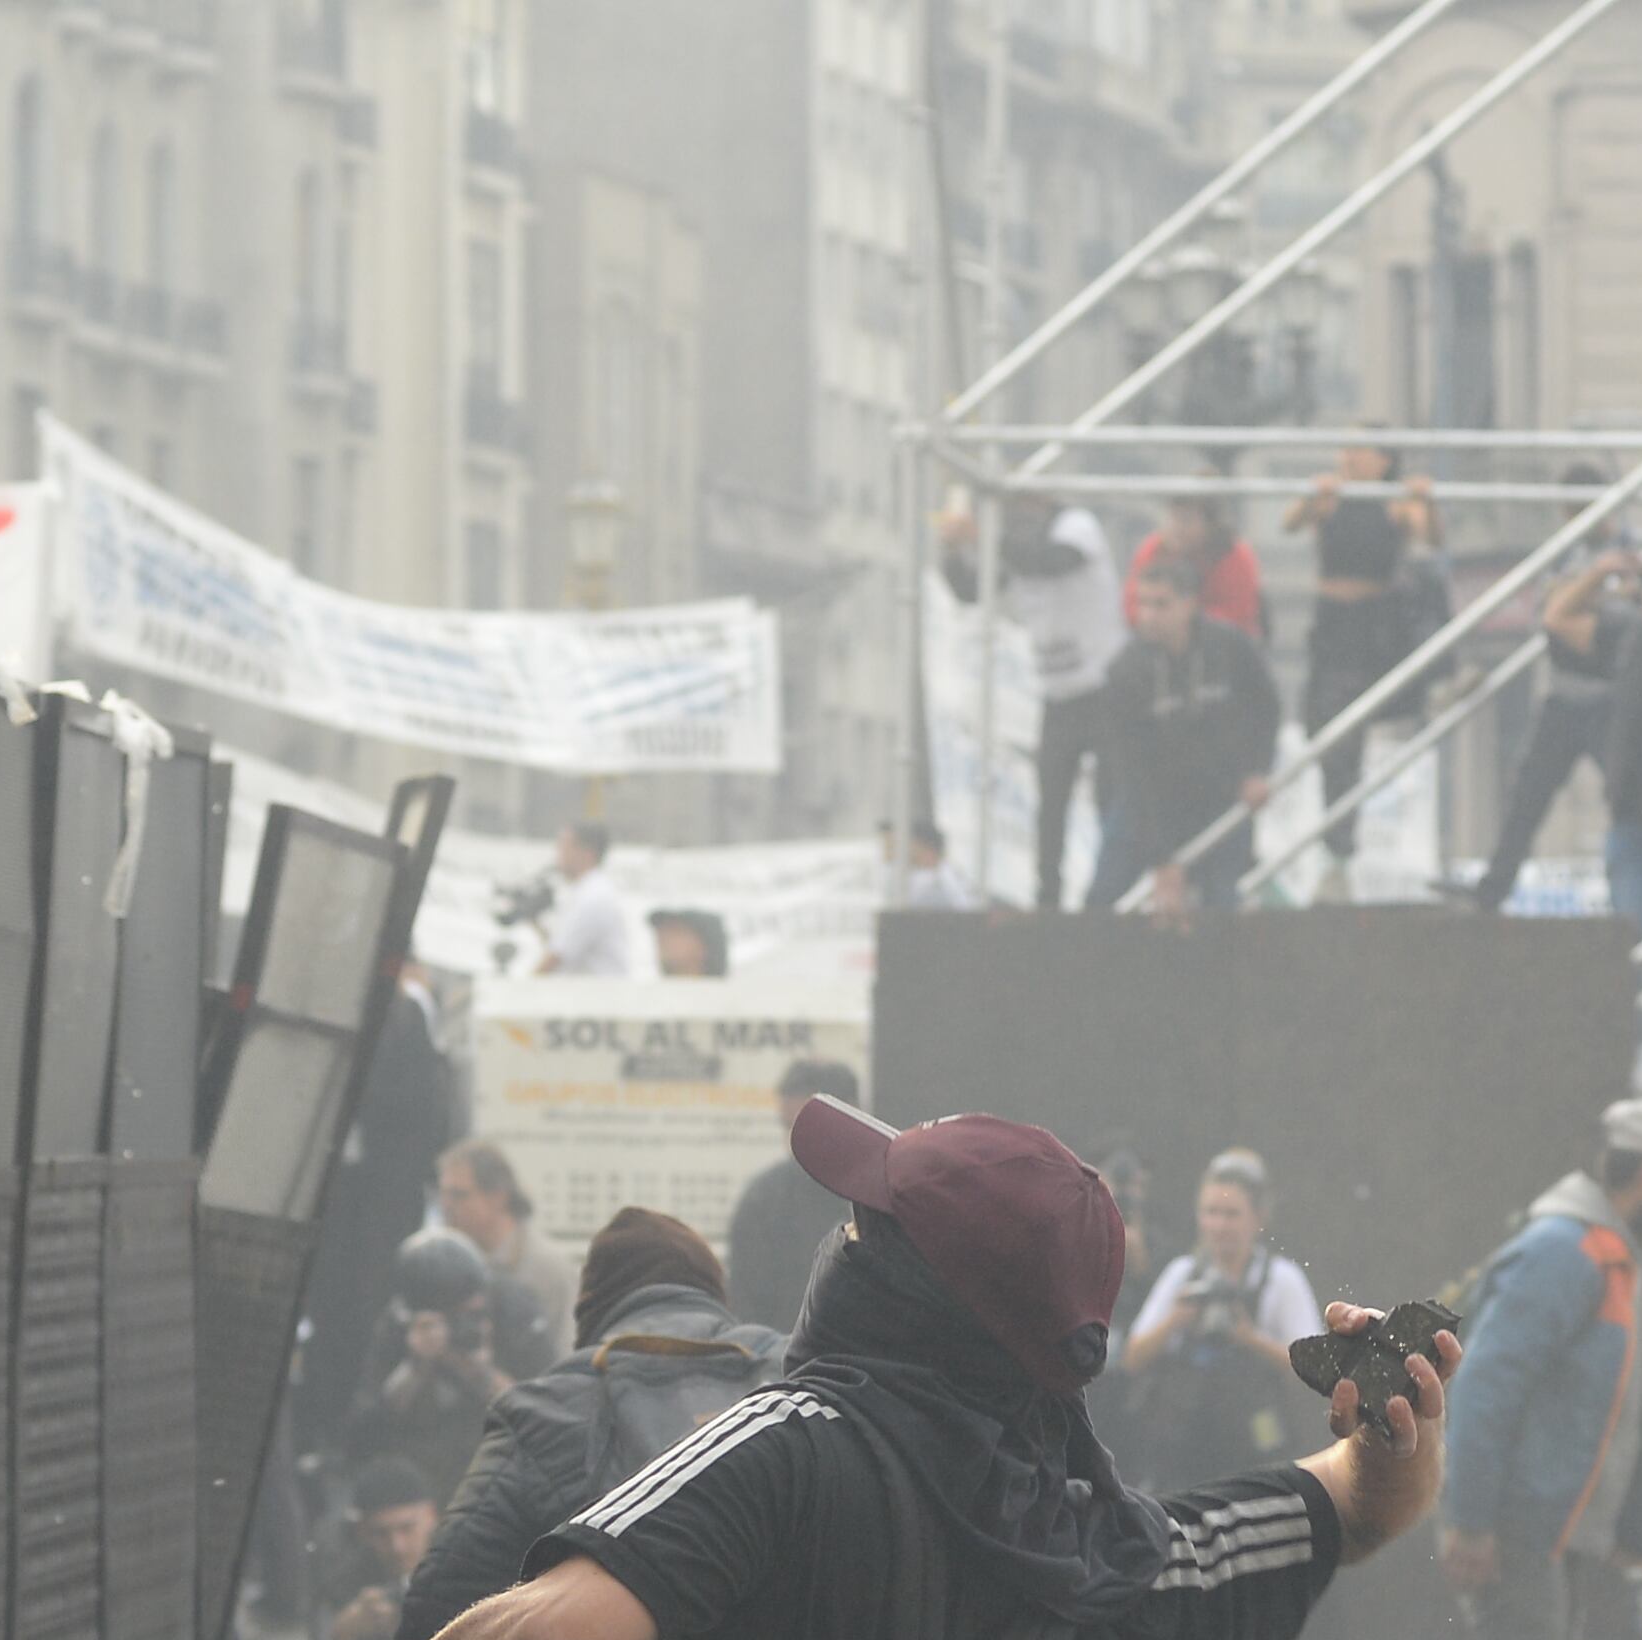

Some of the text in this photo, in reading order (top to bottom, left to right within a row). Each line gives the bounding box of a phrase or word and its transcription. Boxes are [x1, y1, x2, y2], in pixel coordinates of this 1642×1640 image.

[542, 1018, 813, 1050] SOL AL MAR
